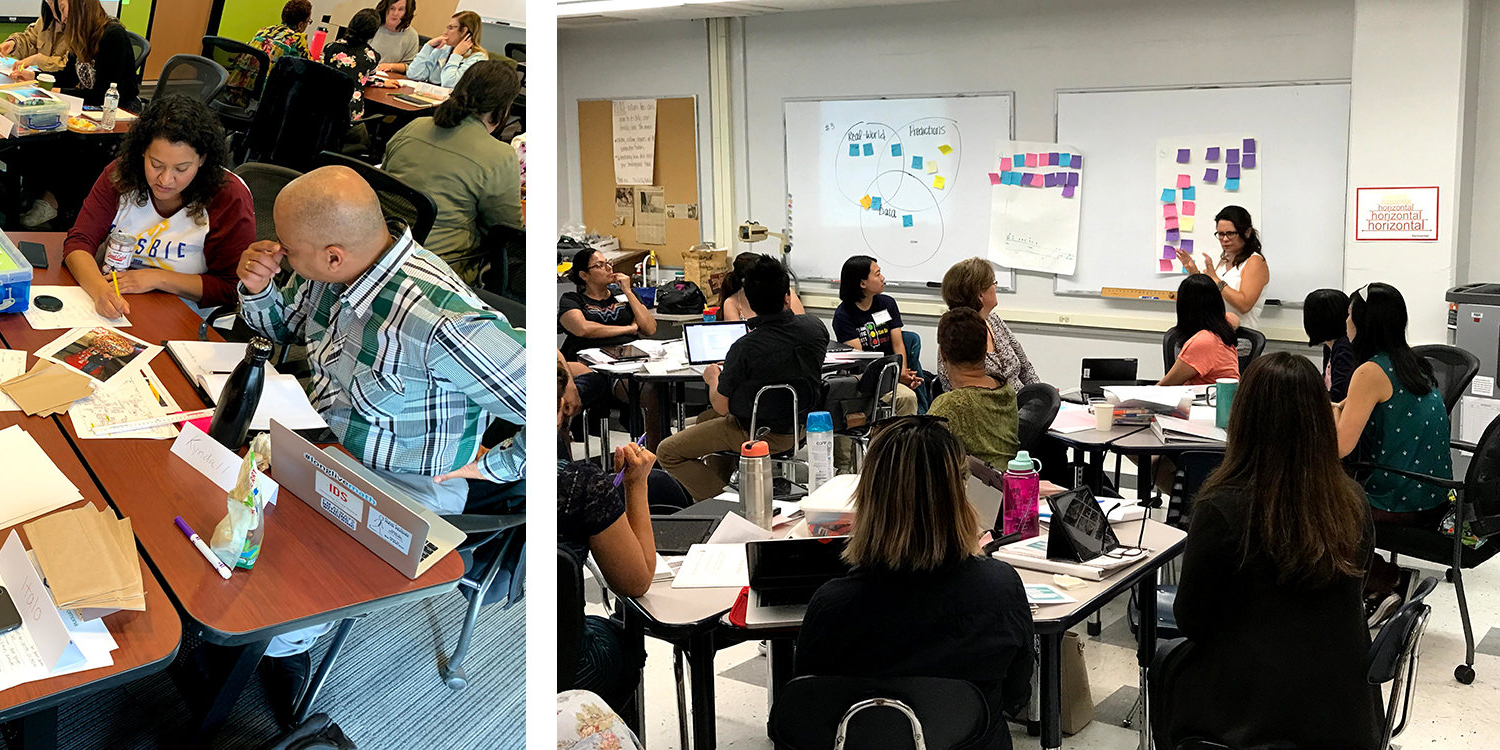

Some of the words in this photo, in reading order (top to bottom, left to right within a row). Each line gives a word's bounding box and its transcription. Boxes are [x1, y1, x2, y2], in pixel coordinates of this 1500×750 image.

[848, 129, 886, 141] Real-World
[909, 125, 946, 137] Predictions
[1378, 203, 1414, 211] horizontal
[1371, 210, 1422, 220] horizontal
[1368, 219, 1424, 231] horizontal
[186, 434, 231, 474] Kyndall
[329, 483, 348, 503] IDS
[20, 576, 42, 621] Italo
